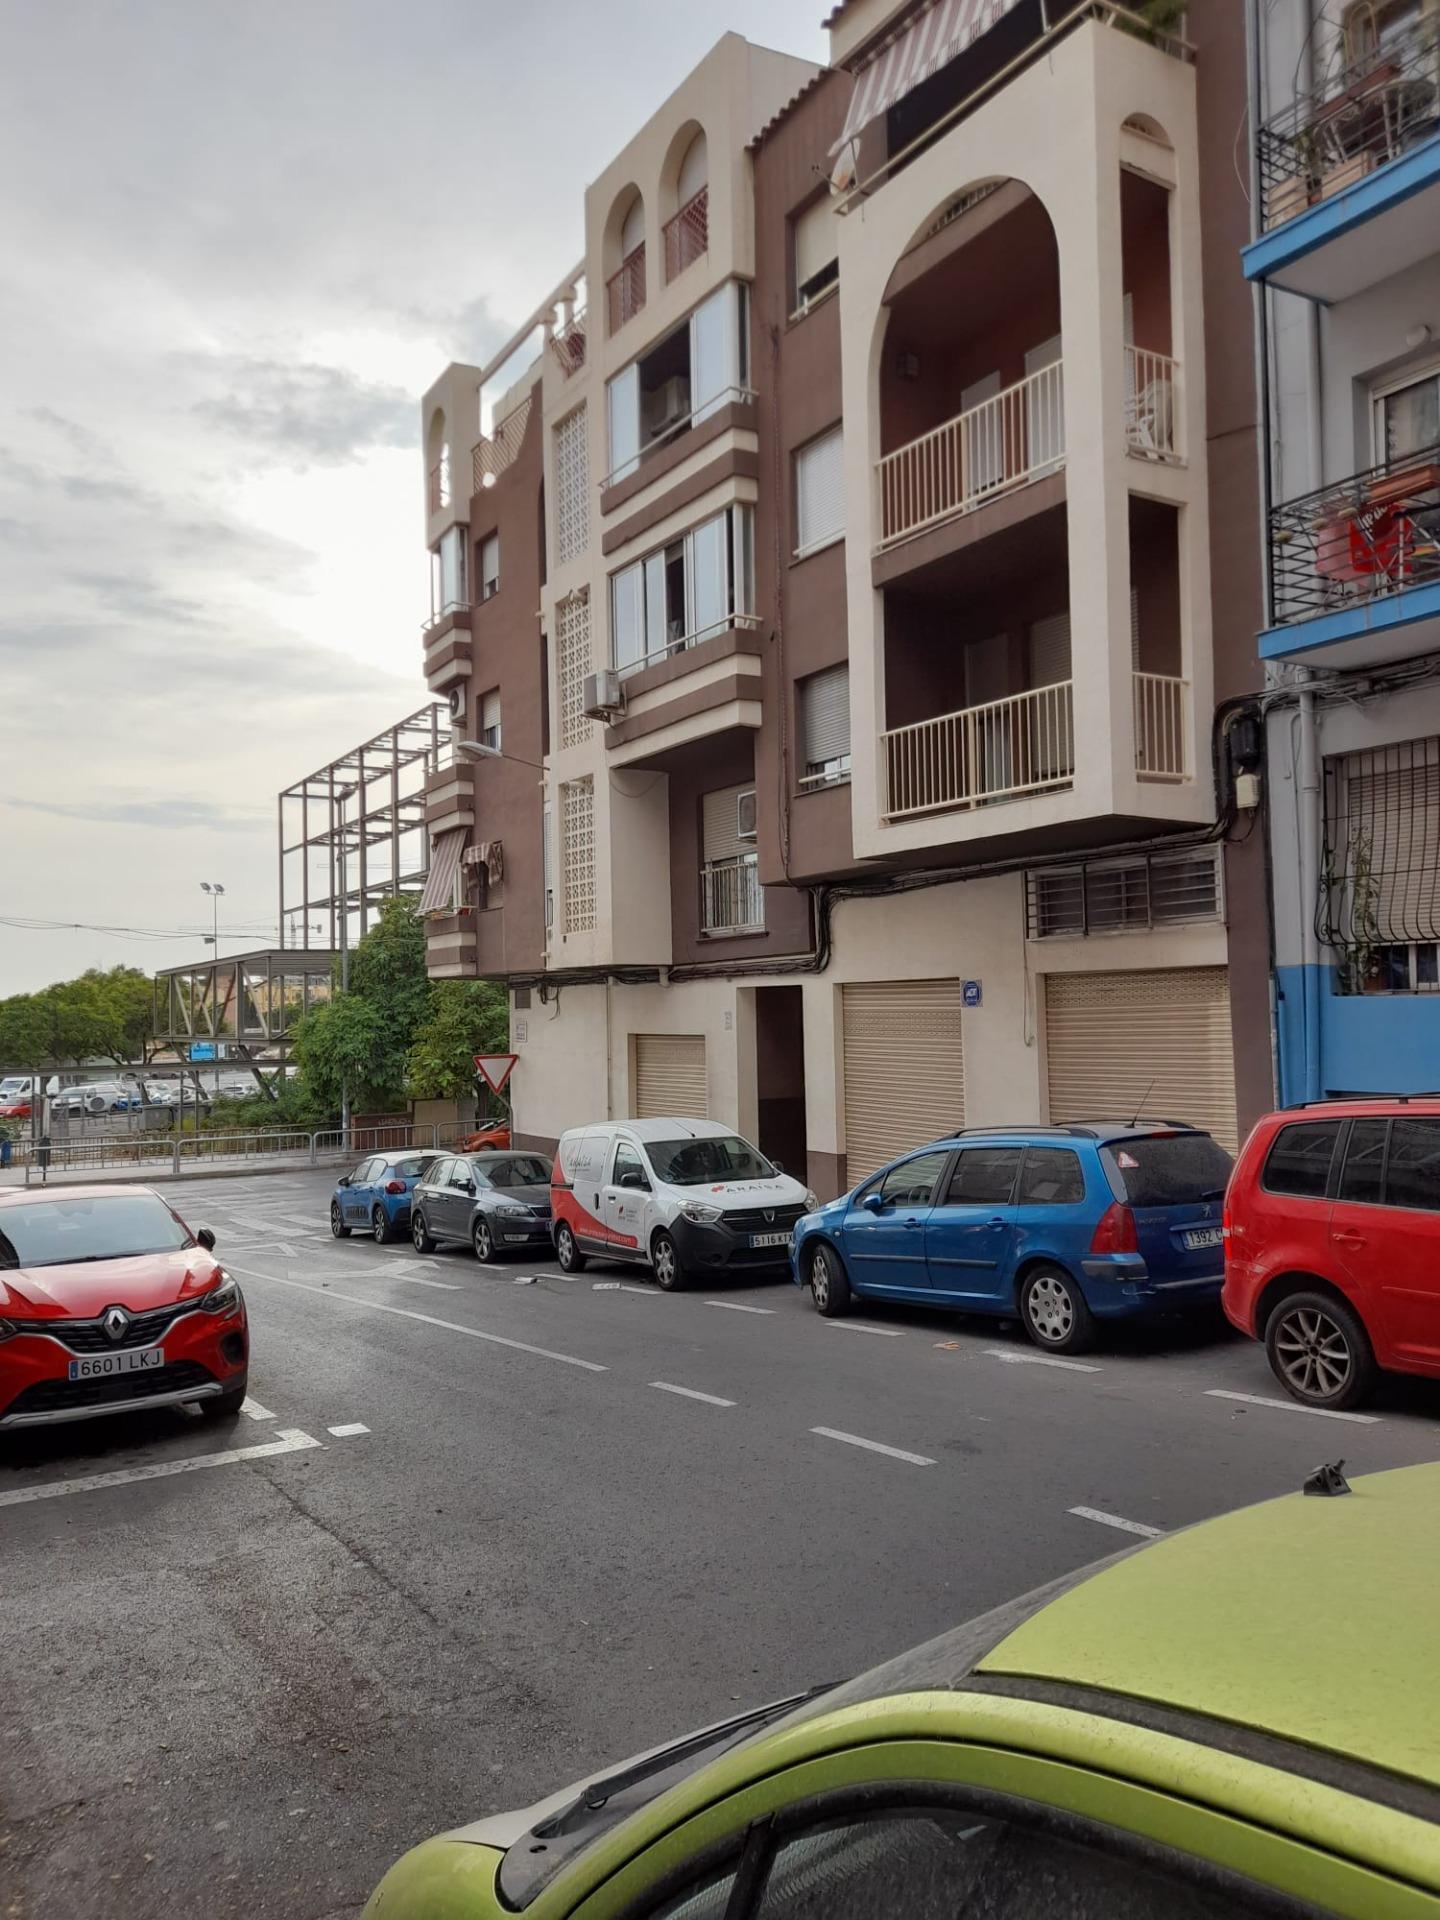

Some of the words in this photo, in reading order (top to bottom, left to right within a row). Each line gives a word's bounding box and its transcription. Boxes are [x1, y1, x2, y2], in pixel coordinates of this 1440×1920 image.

[754, 1235, 776, 1246] 5116
[1189, 1230, 1213, 1245] 1392
[1215, 1228, 1223, 1241] C
[81, 1356, 122, 1376] 6601
[129, 1351, 161, 1369] LKJ
